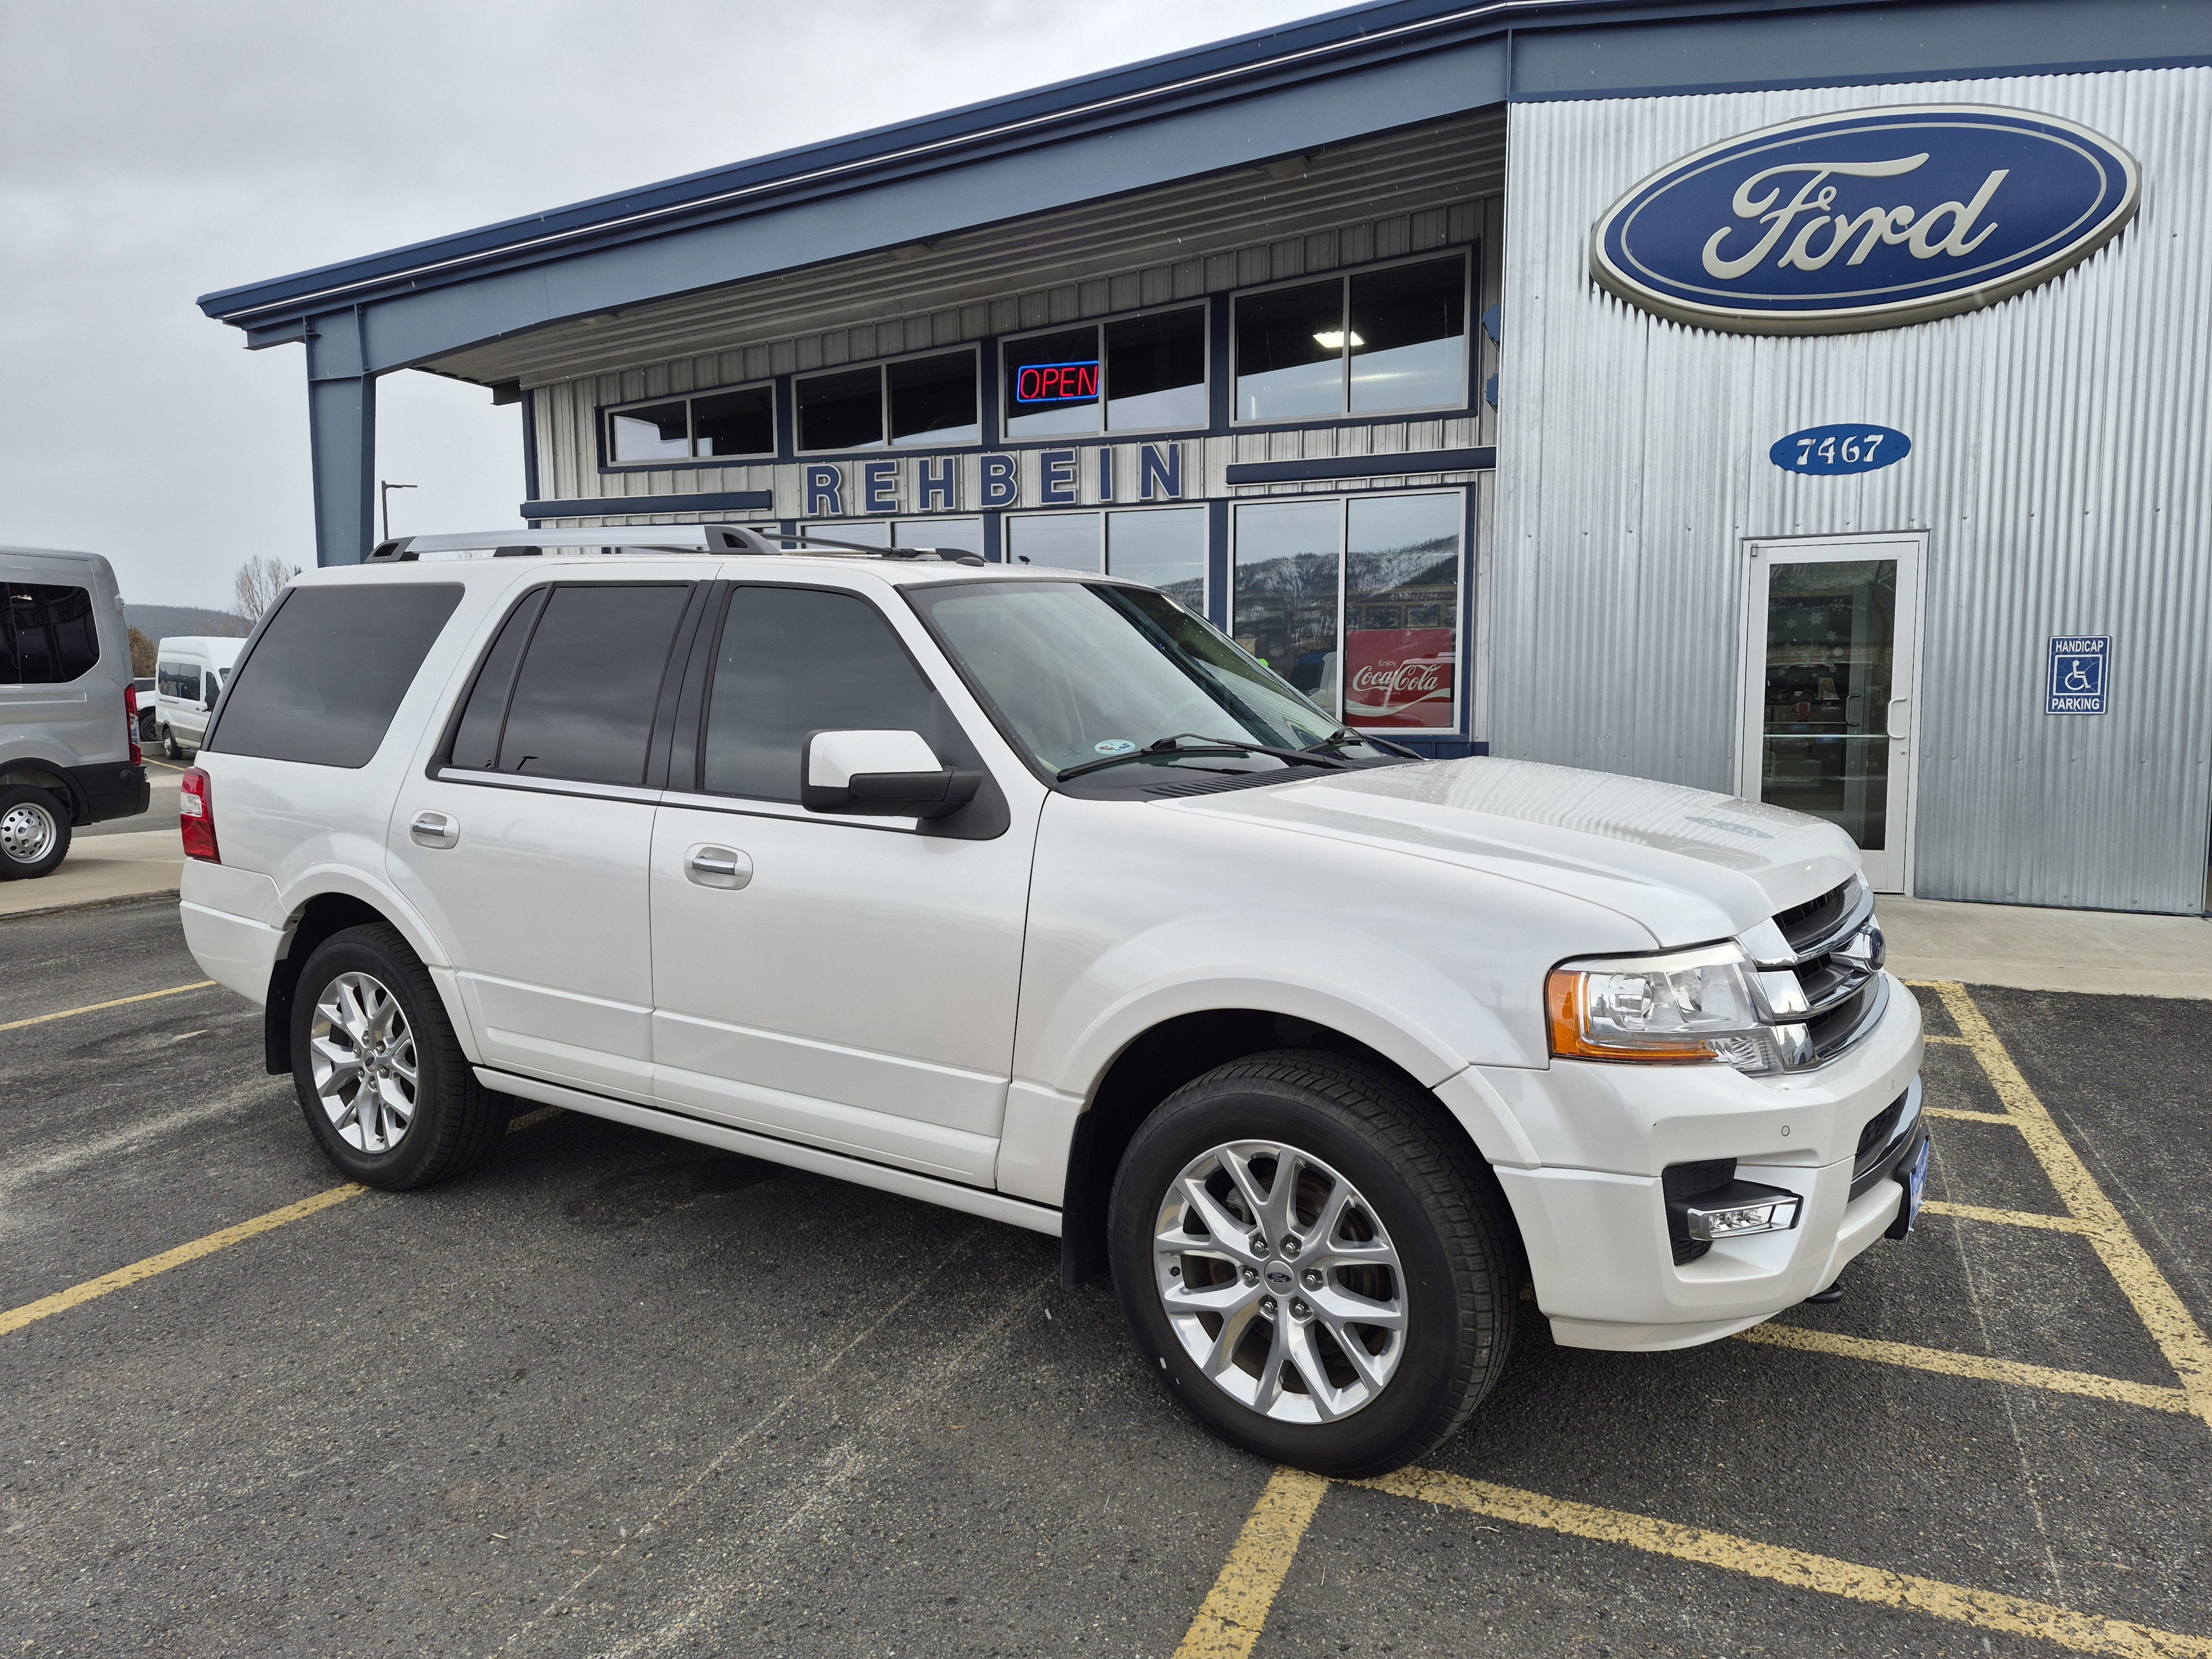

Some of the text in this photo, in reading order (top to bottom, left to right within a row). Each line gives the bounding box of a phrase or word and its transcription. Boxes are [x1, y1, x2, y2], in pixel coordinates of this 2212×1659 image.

[1702, 153, 2010, 280] Ford
[1020, 365, 1098, 399] OPEN
[1797, 434, 1884, 465] 7467
[805, 441, 1182, 517] REHBEIN
[2056, 640, 2104, 653] HANDICAP
[2052, 698, 2100, 710] PARKING
[1271, 1273, 1287, 1282] Ford
